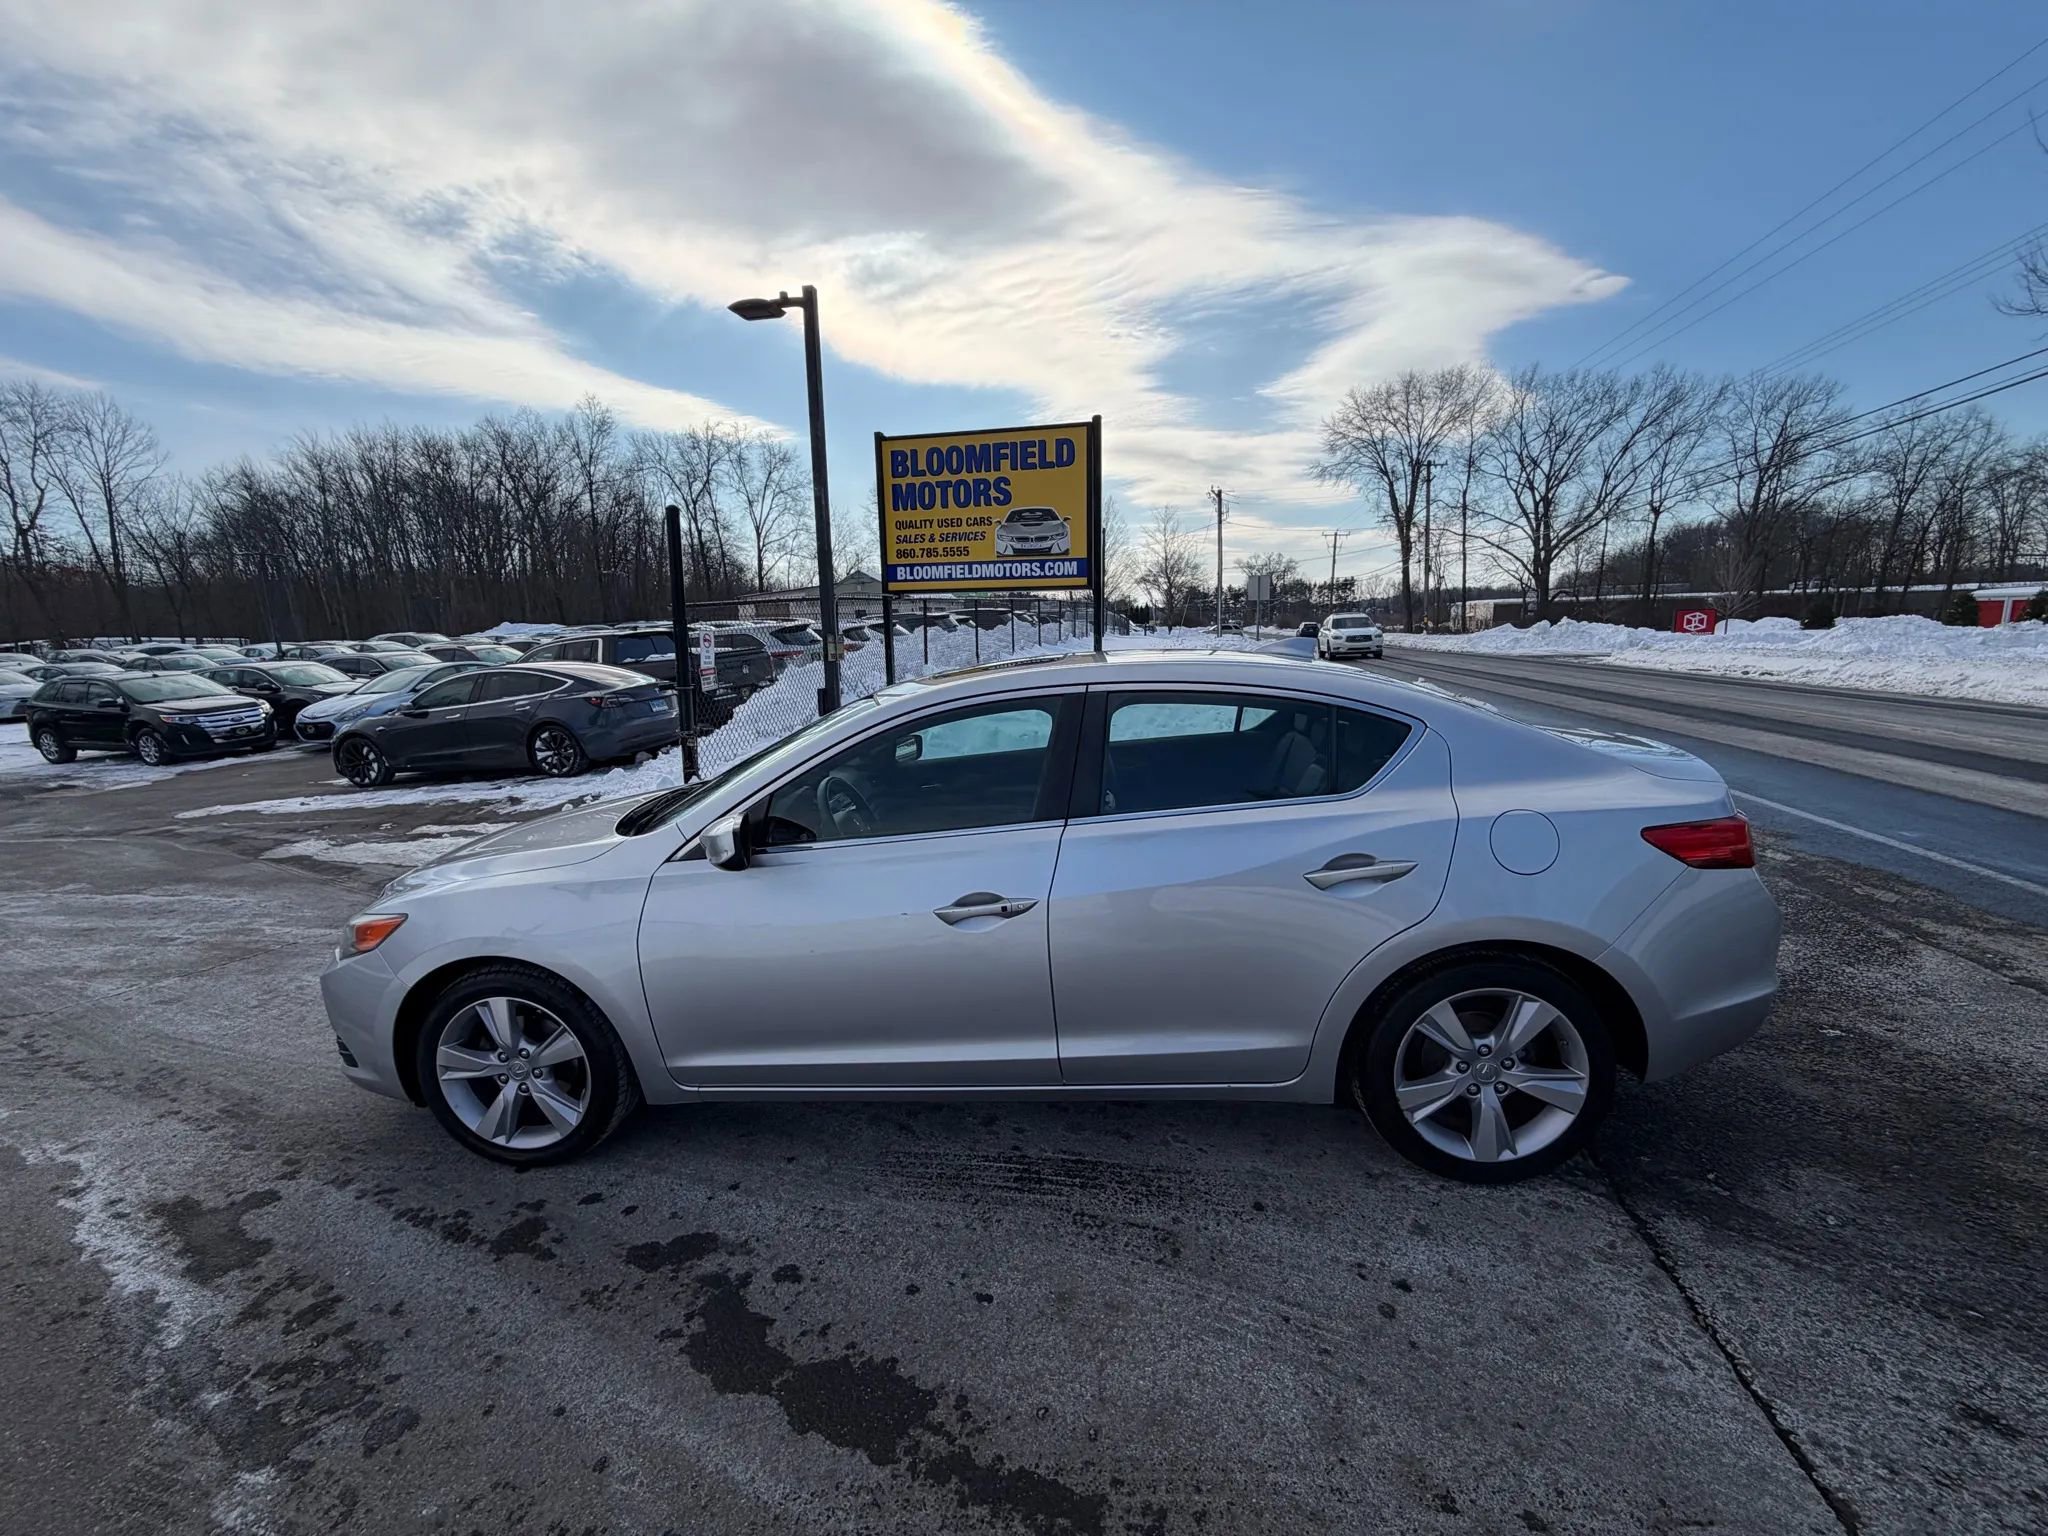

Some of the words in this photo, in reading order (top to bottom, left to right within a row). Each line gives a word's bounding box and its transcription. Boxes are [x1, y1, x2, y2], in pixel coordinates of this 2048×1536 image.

[891, 438, 1076, 478] BLOOMFIELD
[892, 476, 1012, 511] MOTORS
[895, 519, 934, 530] QUALITY
[937, 517, 963, 529] USED
[966, 516, 993, 527] CARS
[896, 534, 926, 544] SALES
[928, 533, 936, 542] &
[938, 531, 987, 542] SERVICES
[896, 546, 970, 559] 860.785.5555
[896, 561, 1078, 580] BLOOMFIELDMOTORS.COM
